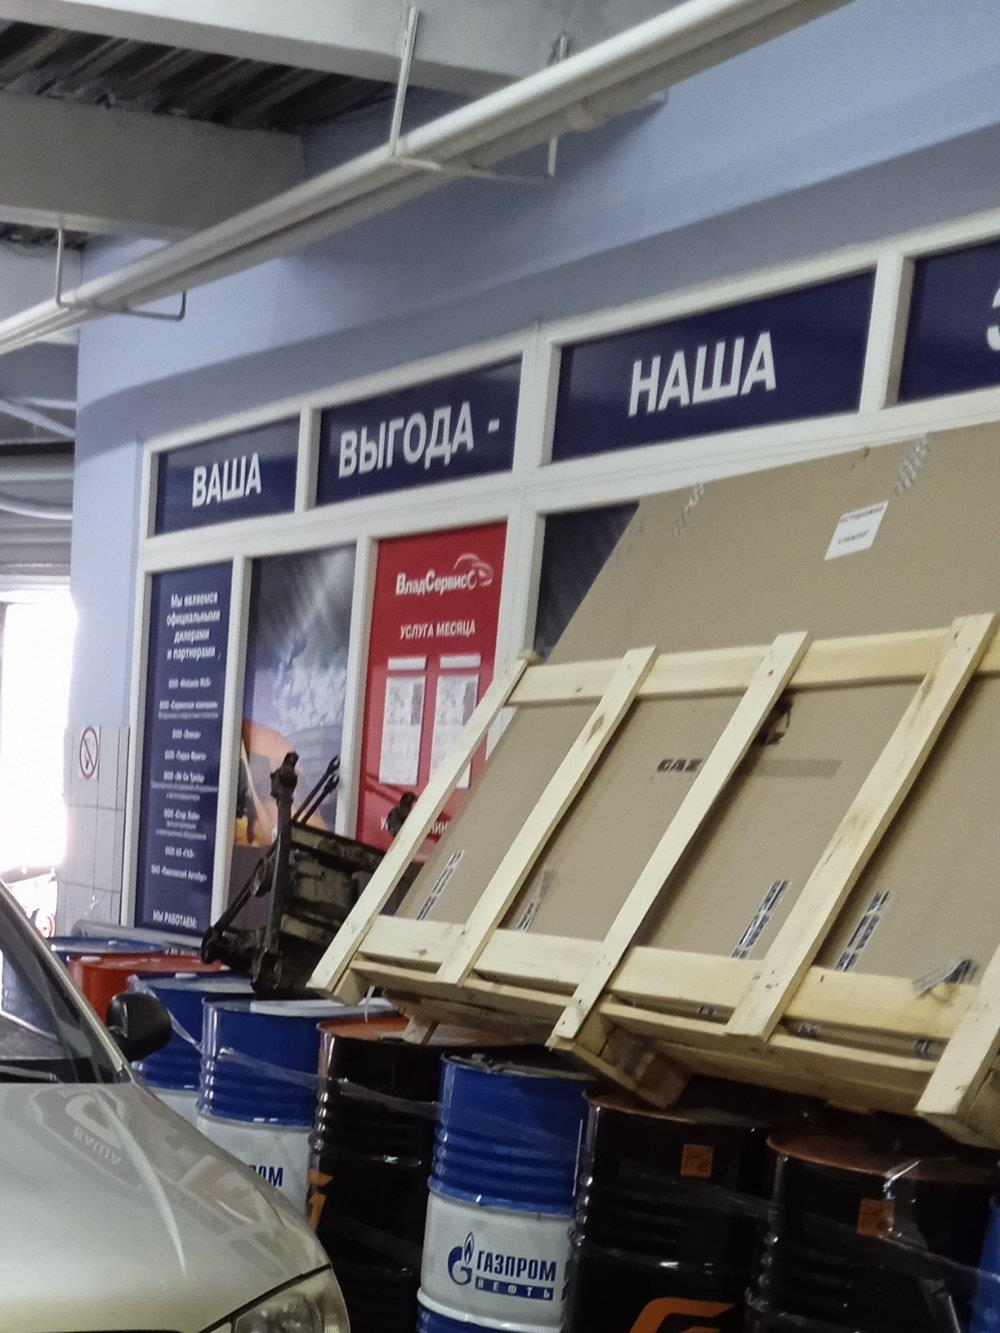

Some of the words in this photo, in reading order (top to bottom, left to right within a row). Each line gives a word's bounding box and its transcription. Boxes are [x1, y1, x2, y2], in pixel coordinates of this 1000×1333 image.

[191, 452, 262, 508] ВАША
[338, 401, 475, 478] ВЫГОДА
[628, 331, 777, 418] НАША
[171, 594, 183, 608] Мы
[184, 592, 219, 607] являемся
[166, 610, 221, 628] официальными
[400, 623, 434, 640] УСЛУГА
[436, 620, 476, 637] МЕСЯЦА
[153, 910, 163, 922] МЫ
[477, 1249, 557, 1282] ГАЗПРОМ
[477, 1279, 550, 1299] НЕФТЬ
